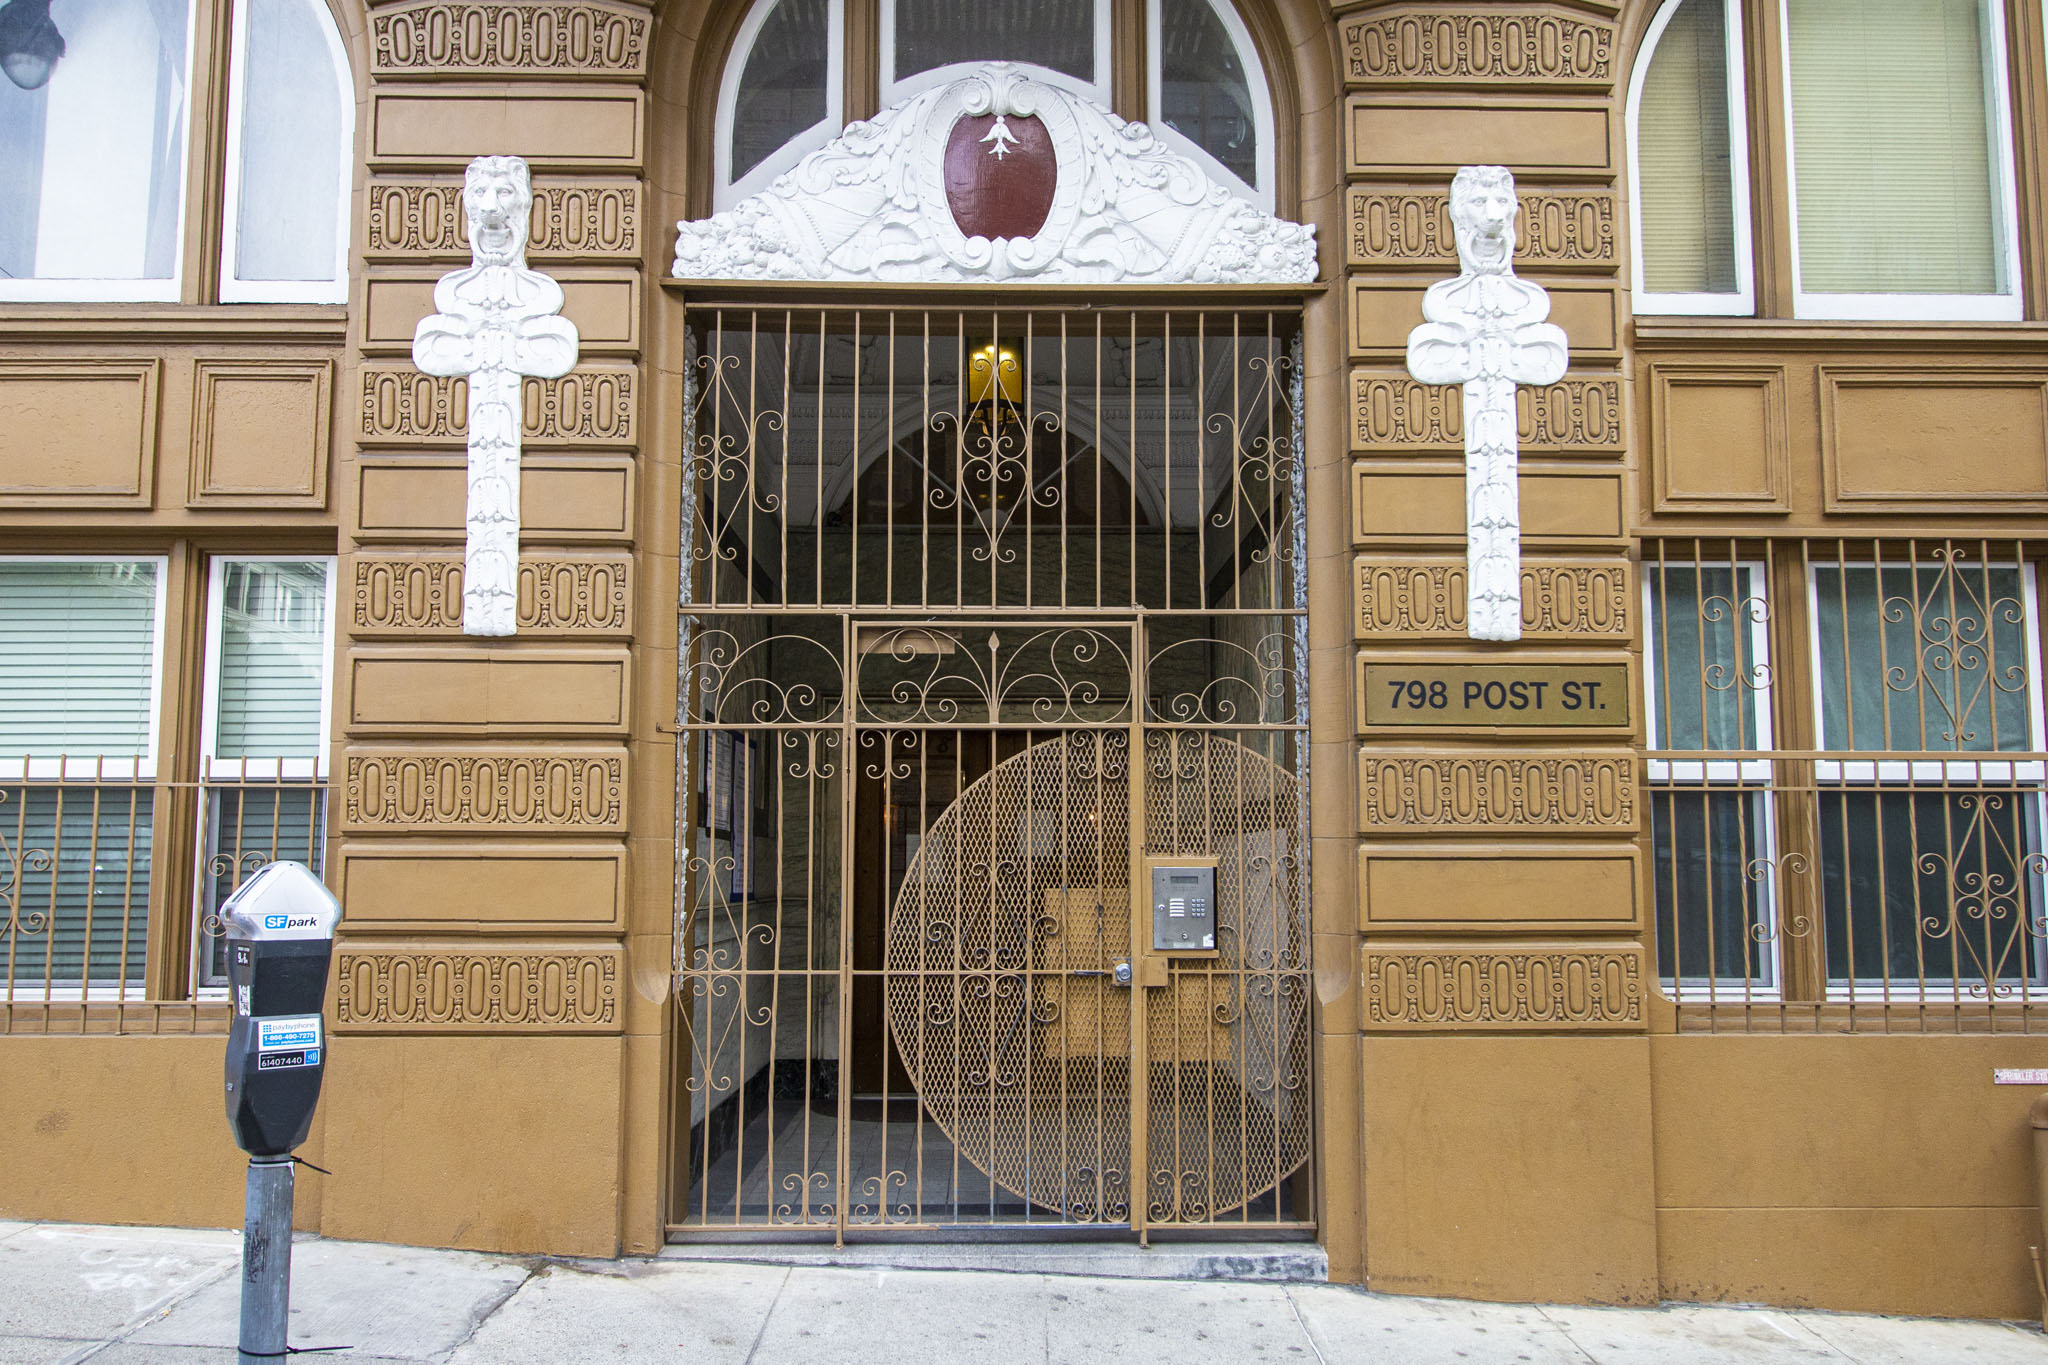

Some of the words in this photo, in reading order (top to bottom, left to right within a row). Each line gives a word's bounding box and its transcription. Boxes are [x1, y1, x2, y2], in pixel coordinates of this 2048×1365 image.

[1388, 680, 1448, 710] 798
[1464, 681, 1548, 711] POST
[1561, 681, 1606, 710] ST.
[273, 1022, 315, 1031] paybyphone
[261, 1056, 303, 1067] 61407440
